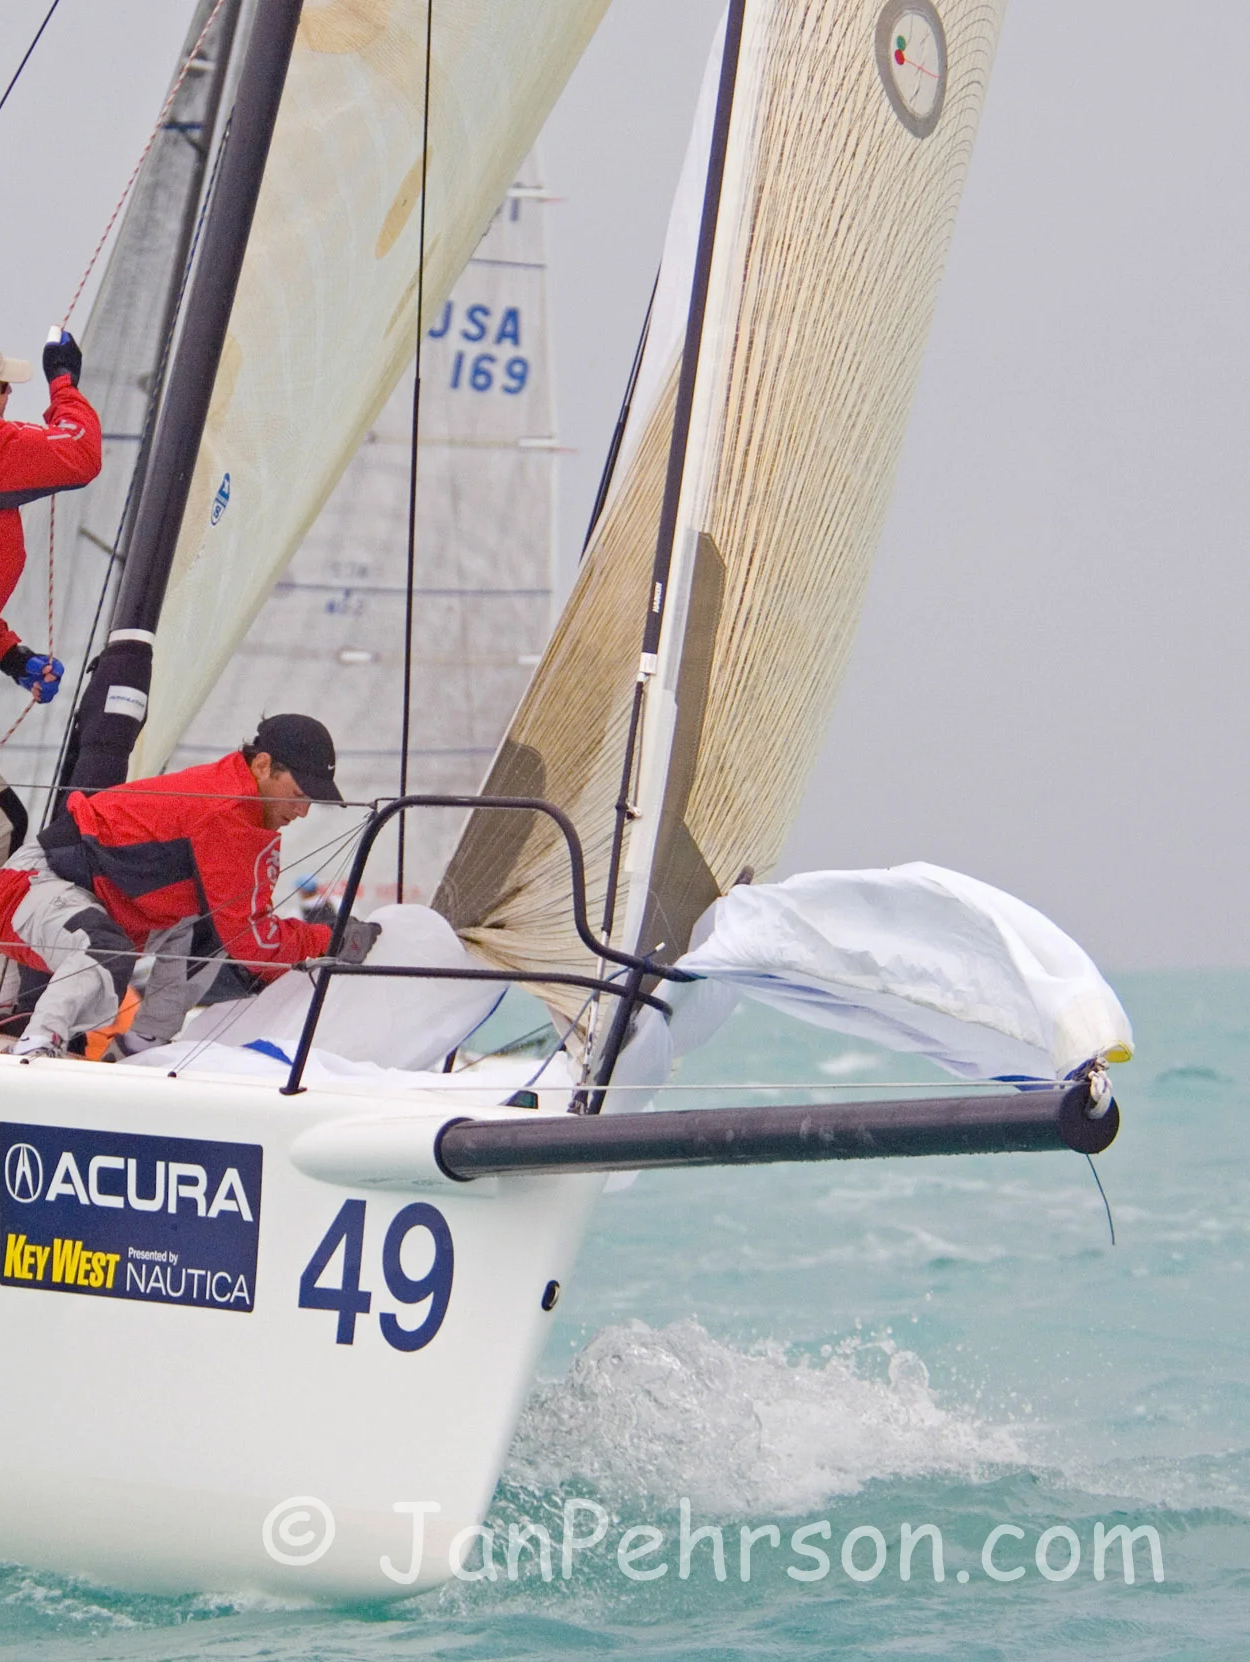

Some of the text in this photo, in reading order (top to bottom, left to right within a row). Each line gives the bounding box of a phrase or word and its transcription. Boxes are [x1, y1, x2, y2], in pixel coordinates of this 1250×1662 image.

[450, 351, 530, 395] 169
[45, 1151, 253, 1222] ACURA
[127, 1246, 179, 1265] Presented by
[298, 1198, 454, 1352] 49
[126, 1262, 250, 1304] NAUTICA
